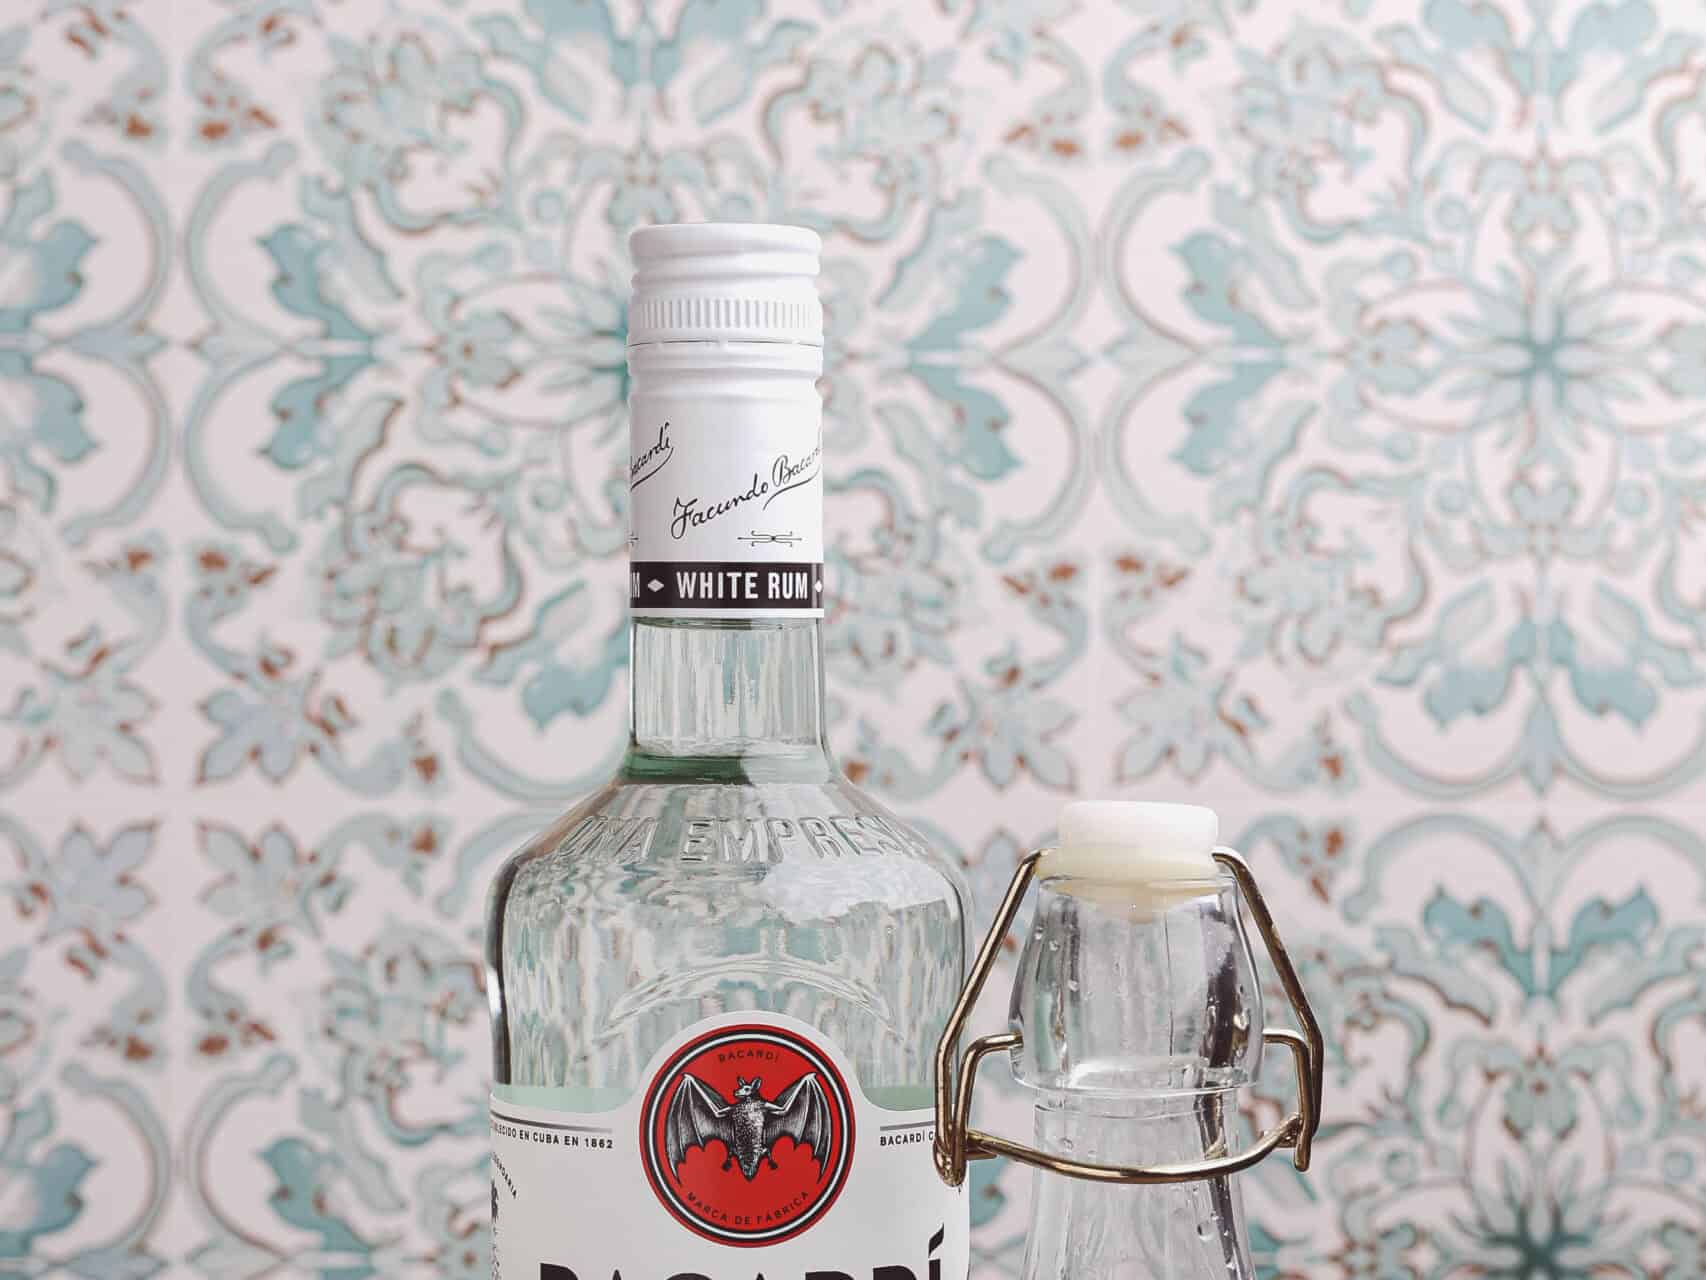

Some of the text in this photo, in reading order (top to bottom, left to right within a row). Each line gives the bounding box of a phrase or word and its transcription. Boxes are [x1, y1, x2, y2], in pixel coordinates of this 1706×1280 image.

[671, 472, 769, 539] Facundo
[676, 571, 809, 600] WHITE RUM
[519, 1130, 530, 1141] EN
[533, 1132, 560, 1145] CUBA
[564, 1135, 579, 1147] EN
[585, 1138, 613, 1149] 1862
[687, 1191, 728, 1223] MARCA
[735, 1216, 751, 1225] DE
